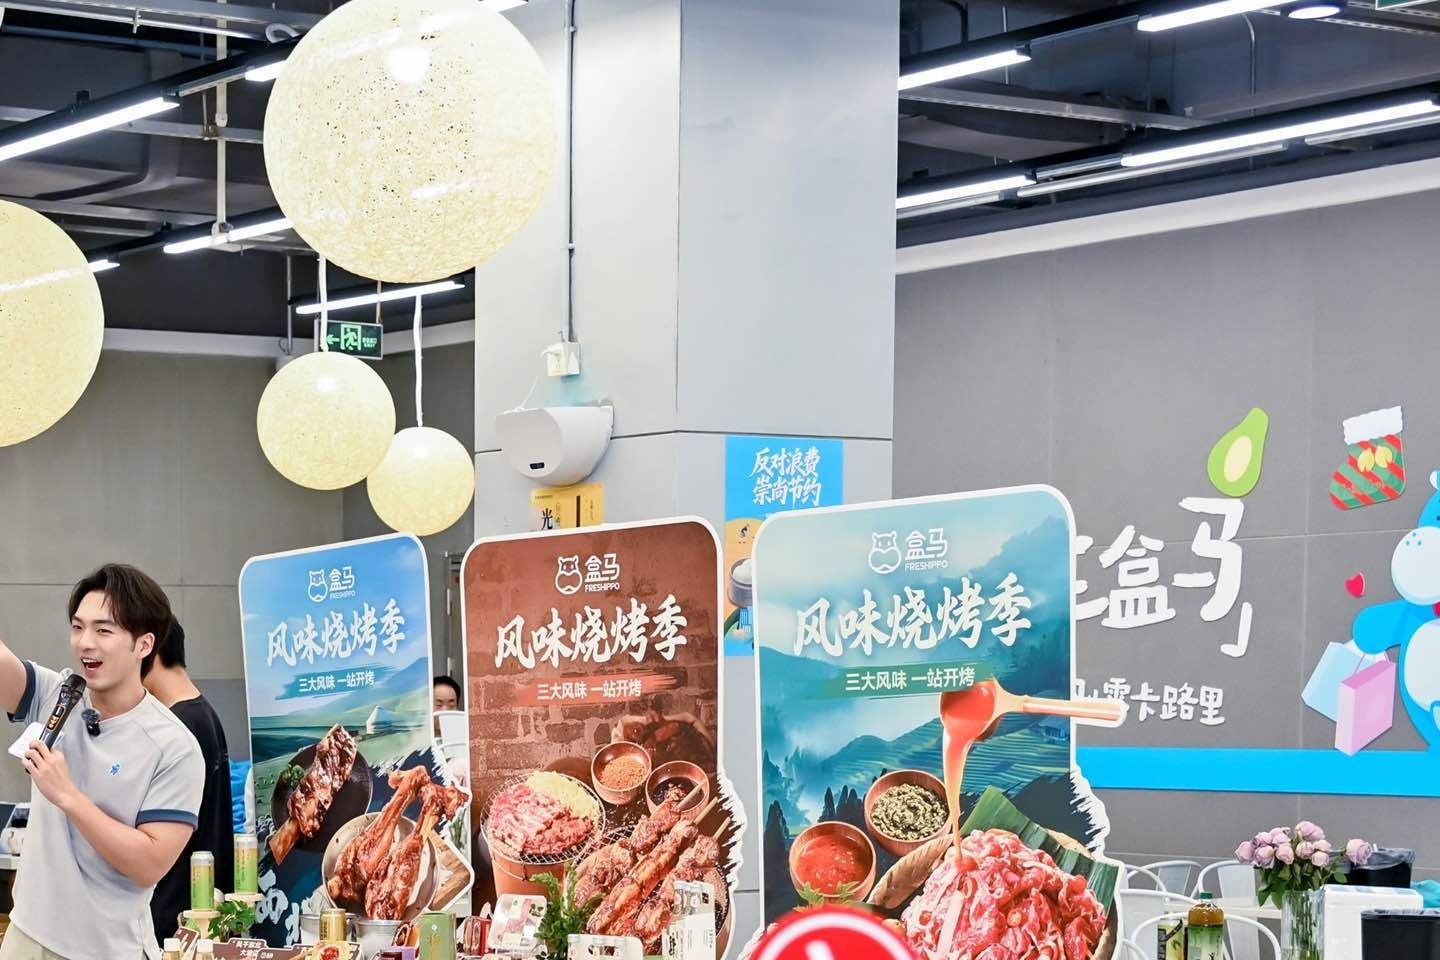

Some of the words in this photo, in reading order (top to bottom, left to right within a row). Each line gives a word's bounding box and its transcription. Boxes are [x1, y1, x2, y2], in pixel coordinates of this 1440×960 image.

[749, 446, 821, 478] 反对浪费
[752, 473, 822, 509] 崇尚节约
[905, 528, 948, 561] 盒马
[329, 566, 355, 592] 盒马
[584, 553, 620, 583] 盒马
[905, 559, 949, 572] FRESHIPPO
[1075, 497, 1253, 657] 盒马」
[585, 582, 620, 593] FRESHIPPO
[793, 571, 1033, 657] 风味烧烤季
[267, 598, 406, 667] 风味烧烤季
[494, 593, 688, 669] 风味烧烤季
[298, 674, 336, 692] 三大风味
[337, 670, 376, 689] 一站开烤
[536, 682, 588, 700] 三大风味
[590, 679, 642, 698] 一站开烤
[845, 671, 908, 692] 三大风味
[911, 666, 976, 688] 一站开烤
[1075, 678, 1225, 726] 零卡路里
